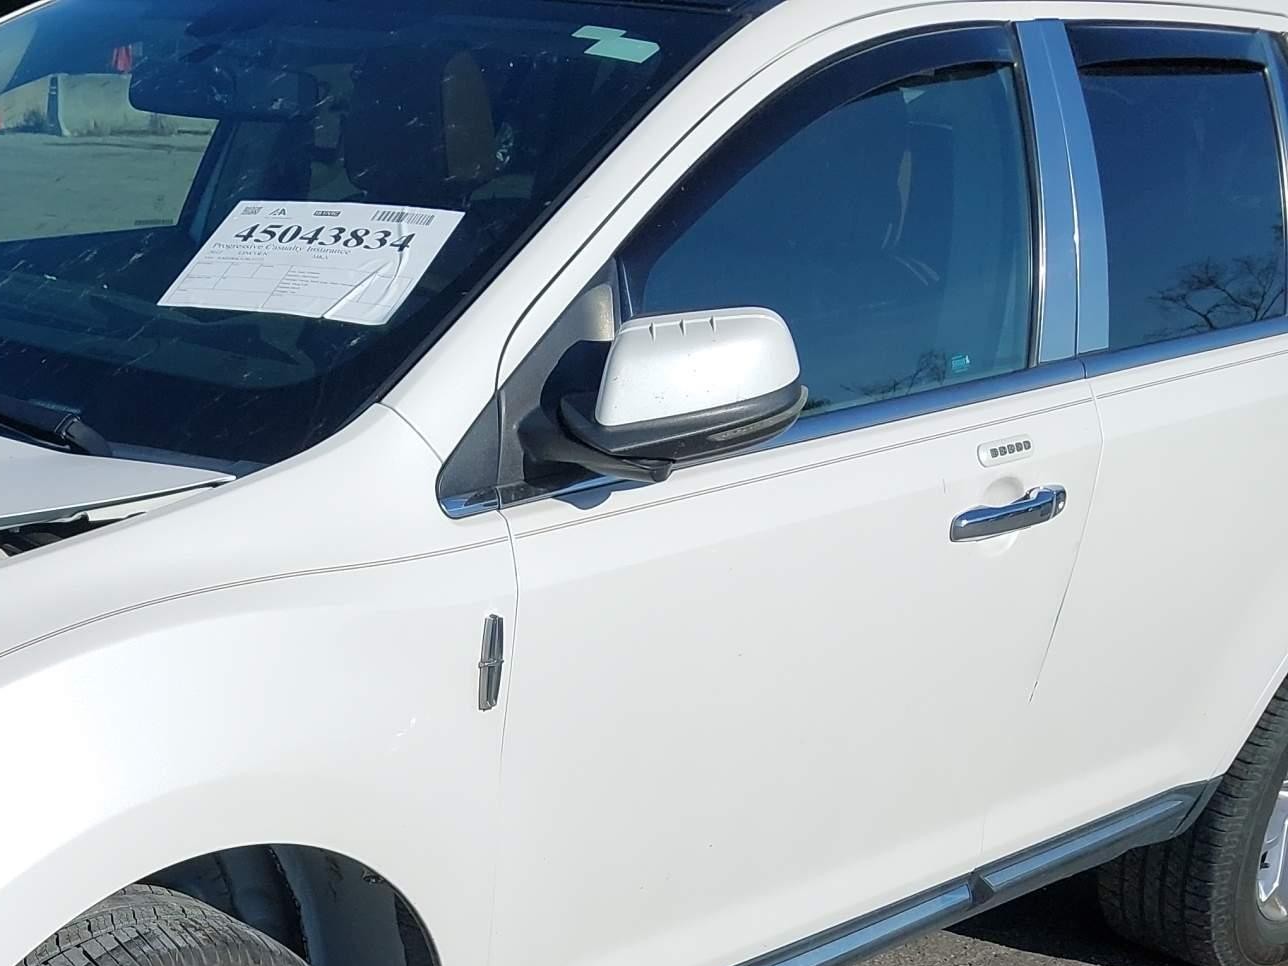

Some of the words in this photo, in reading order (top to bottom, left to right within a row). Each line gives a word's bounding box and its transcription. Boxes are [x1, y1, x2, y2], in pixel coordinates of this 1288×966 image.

[212, 242, 264, 250] Progressive
[265, 244, 304, 252] Casualty
[306, 246, 351, 255] Insurance
[233, 223, 416, 253] 45043834
